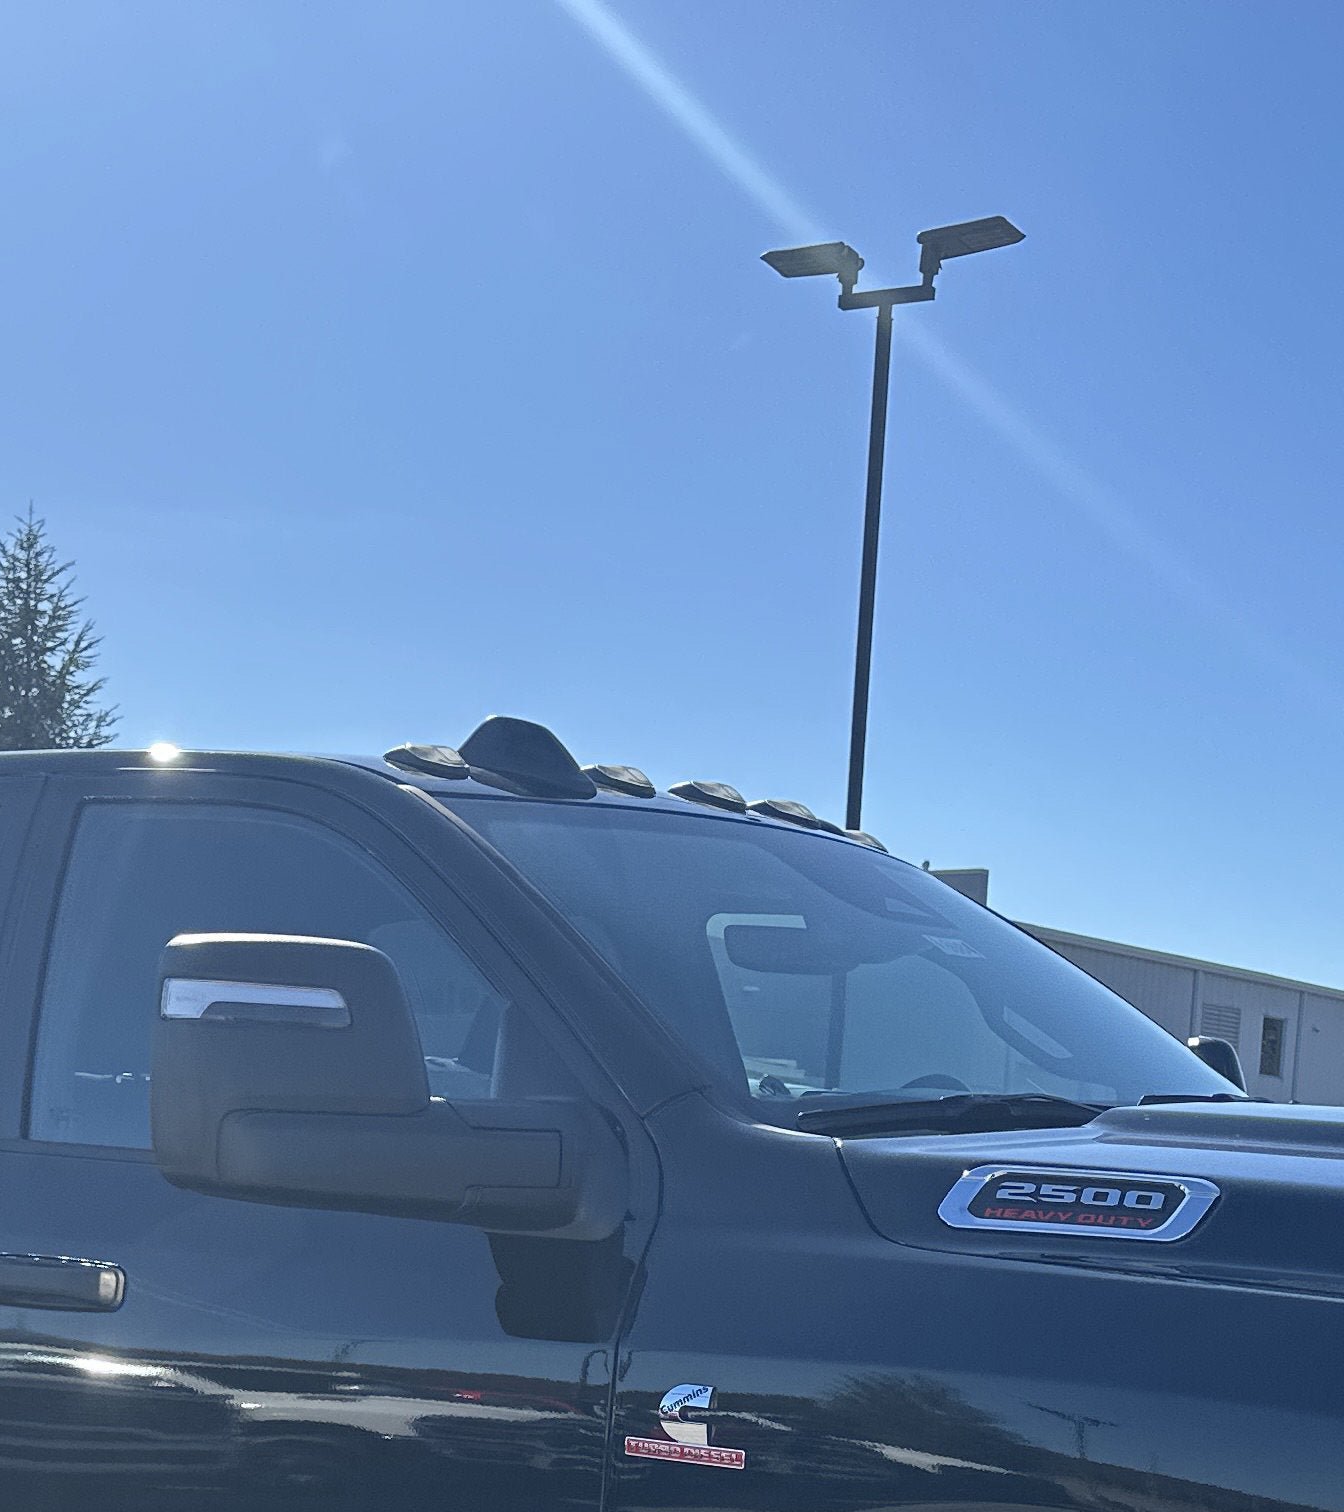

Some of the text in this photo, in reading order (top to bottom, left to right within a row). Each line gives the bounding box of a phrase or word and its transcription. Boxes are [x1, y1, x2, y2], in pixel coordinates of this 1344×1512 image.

[995, 1181, 1166, 1210] 2500
[983, 1206, 1154, 1228] HEAVY DUTY
[659, 1386, 709, 1415] Cummins
